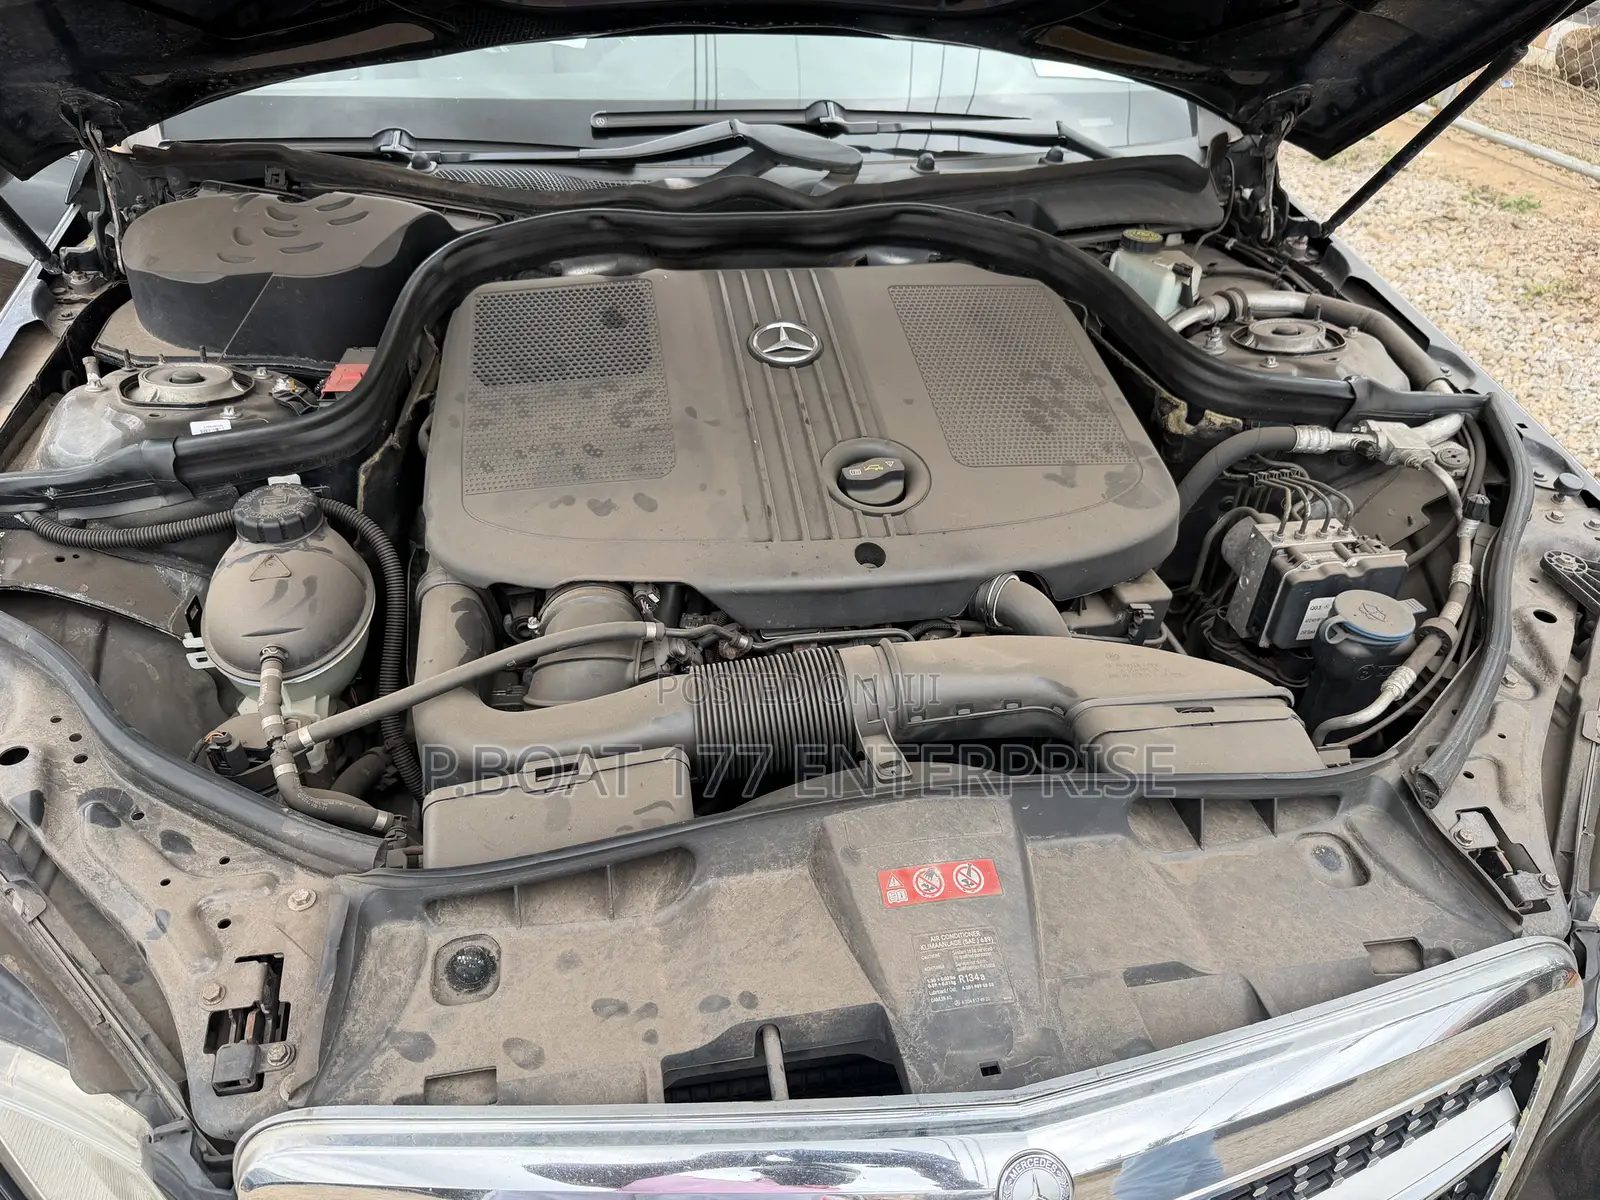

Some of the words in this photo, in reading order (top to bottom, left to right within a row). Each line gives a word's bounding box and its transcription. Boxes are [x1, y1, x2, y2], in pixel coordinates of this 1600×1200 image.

[941, 930, 981, 941] CONDITIONER
[920, 939, 962, 951] KLIMAANLAGE
[958, 972, 986, 984] R134a
[1009, 1157, 1058, 1180] MERCEDES
